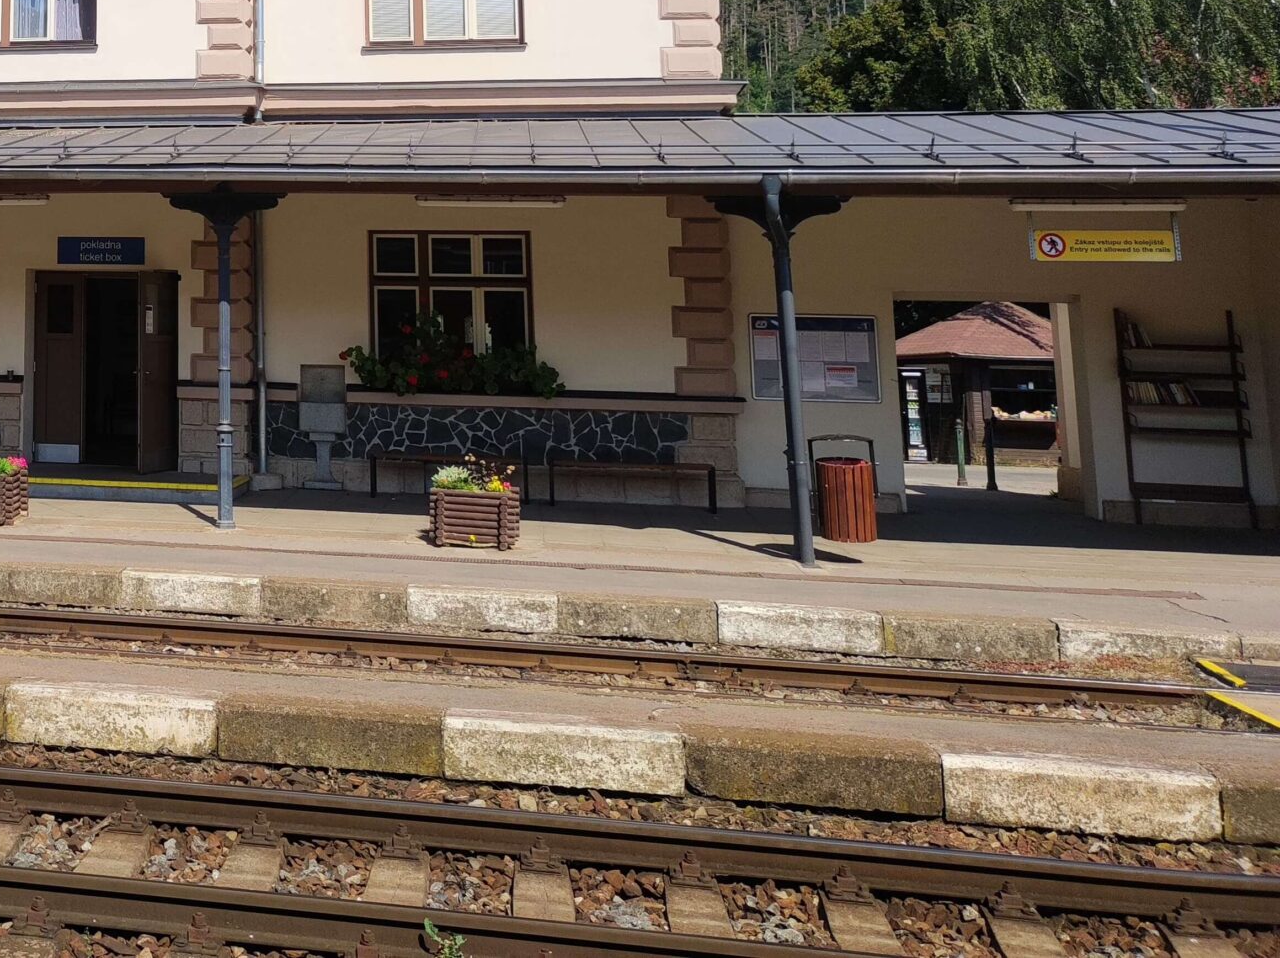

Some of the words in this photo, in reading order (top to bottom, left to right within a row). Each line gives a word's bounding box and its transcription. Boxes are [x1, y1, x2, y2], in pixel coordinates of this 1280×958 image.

[80, 239, 122, 251] pokladna
[79, 252, 104, 262] ticket
[105, 252, 122, 262] box
